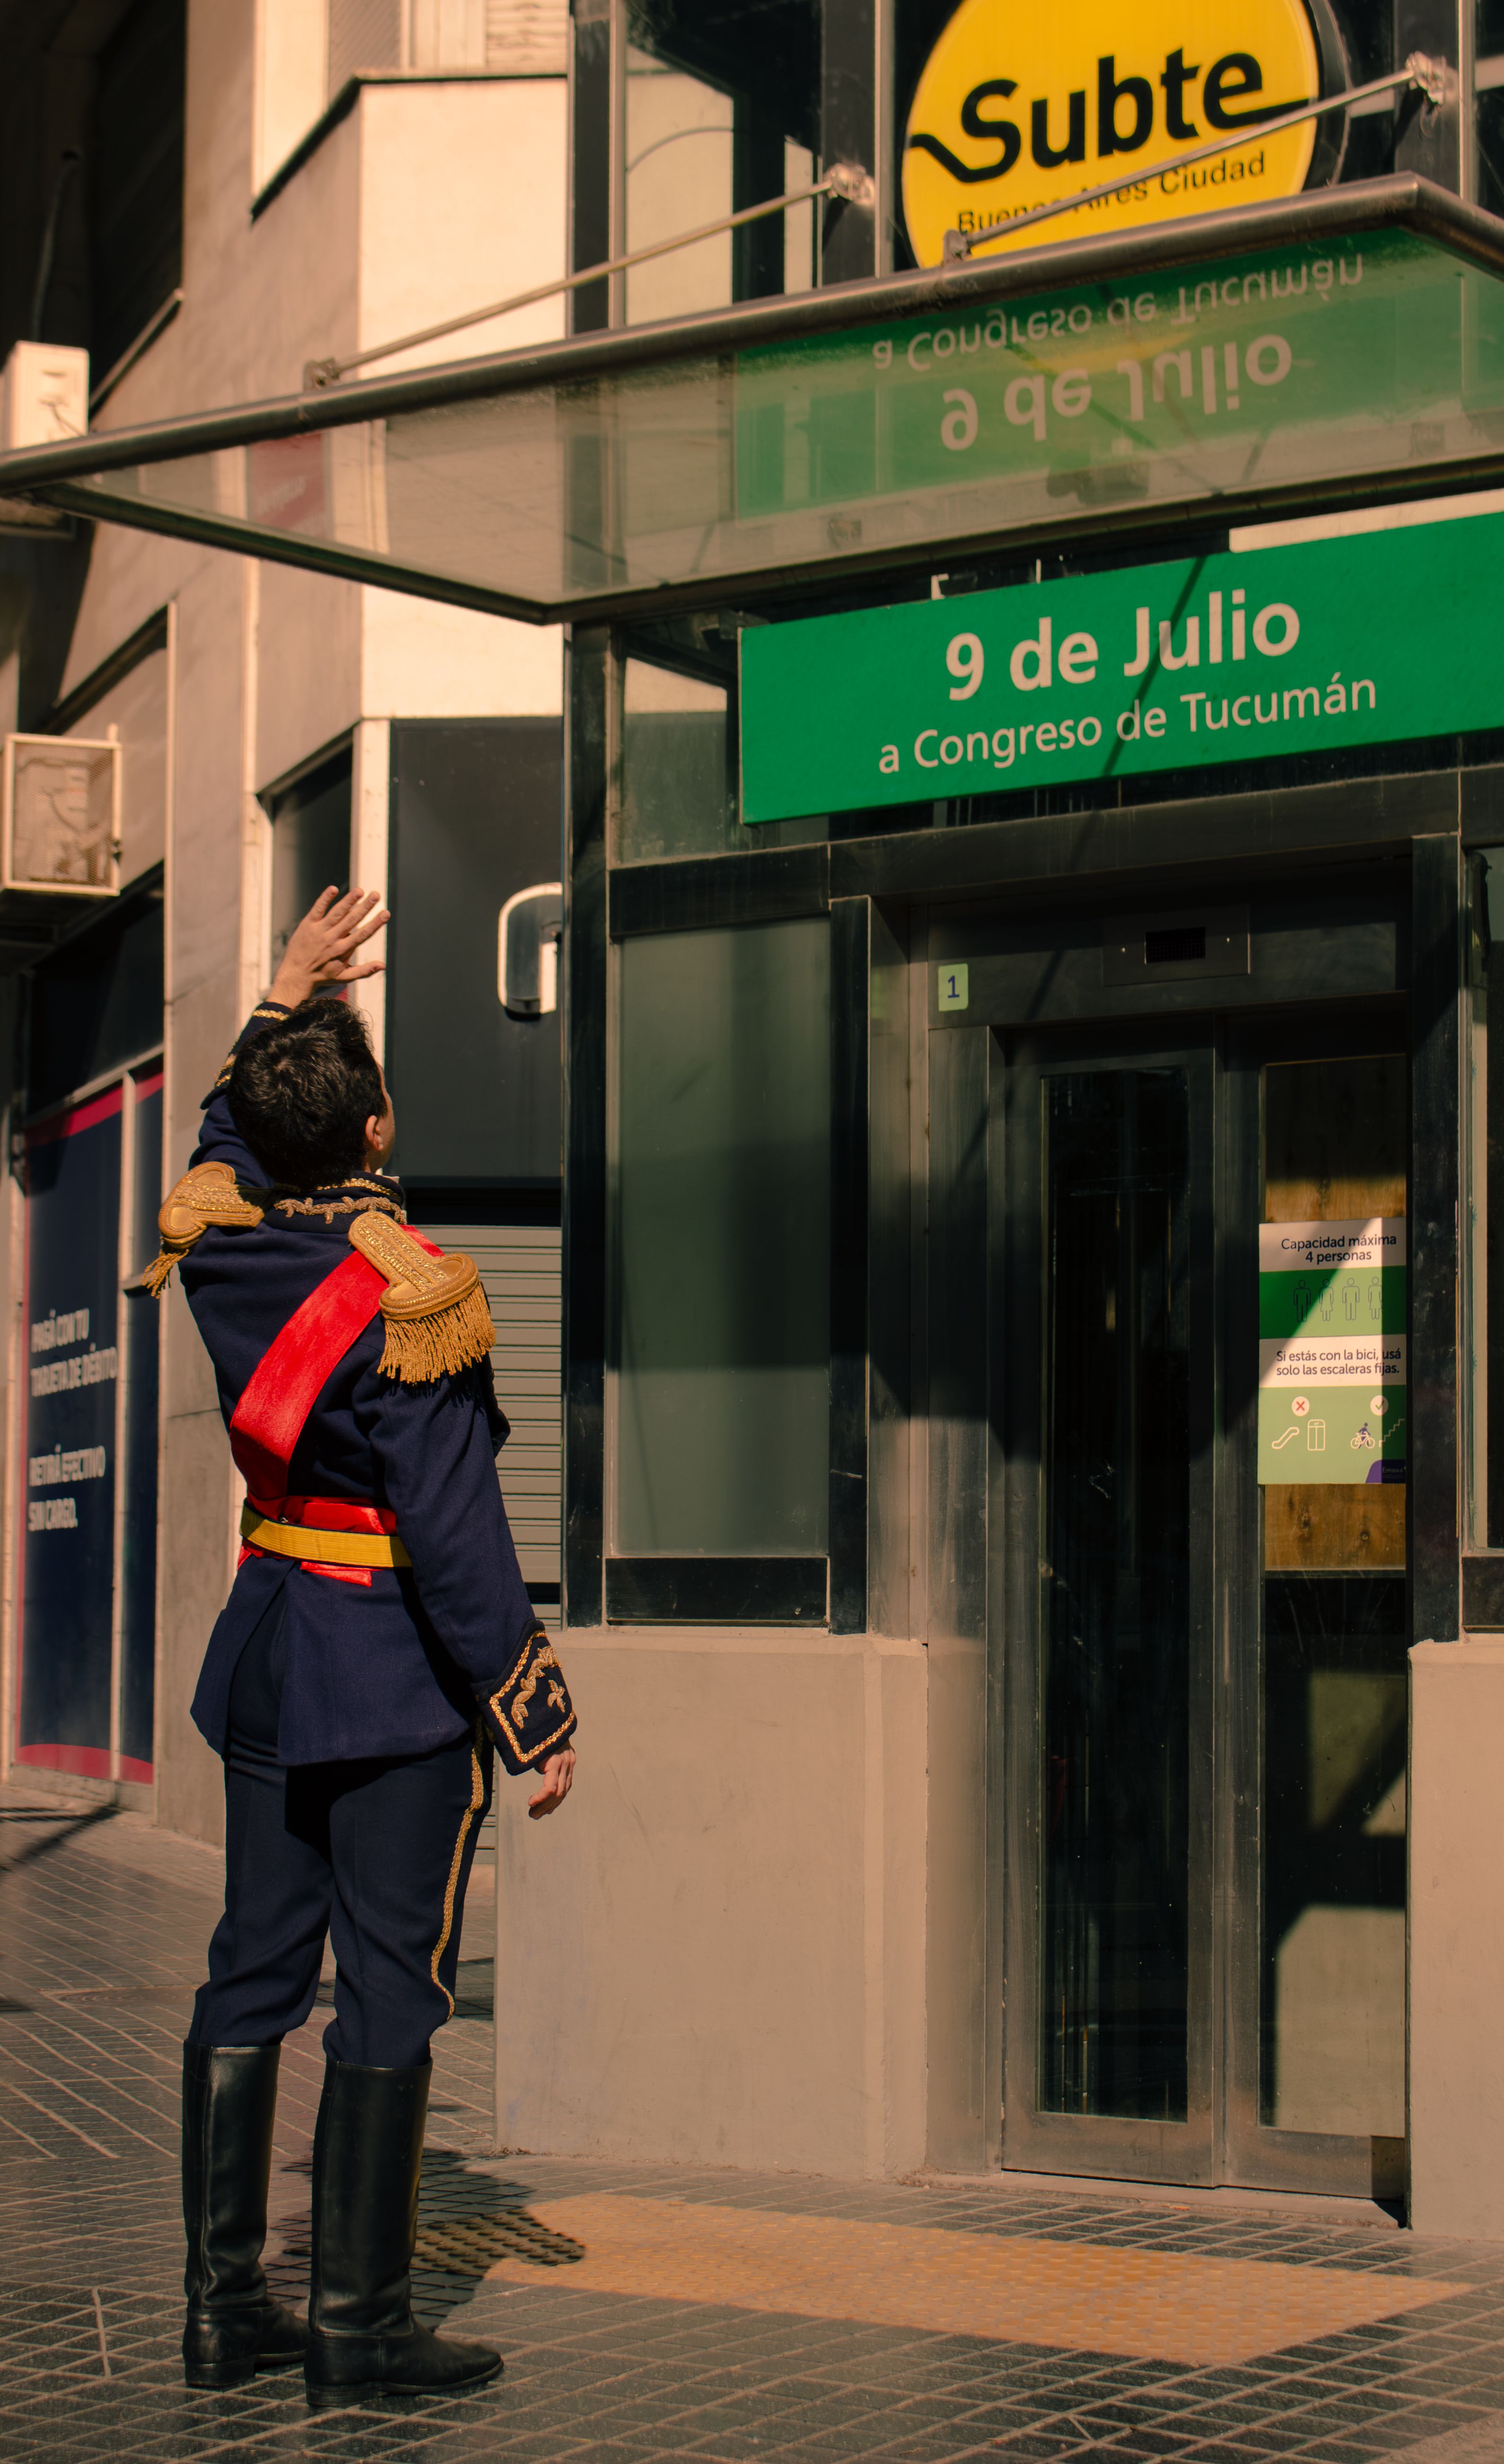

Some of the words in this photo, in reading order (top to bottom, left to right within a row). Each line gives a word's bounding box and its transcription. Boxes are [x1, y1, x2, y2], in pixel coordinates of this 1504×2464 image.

[910, 46, 1310, 185] Subte
[1159, 151, 1265, 195] Ciudad
[947, 633, 984, 701] 9
[1009, 616, 1099, 691] de
[1124, 588, 1301, 677] Julio
[879, 744, 899, 774] a
[914, 716, 1102, 769] Congreso
[1116, 700, 1167, 741] de
[1180, 672, 1377, 733] Tucumán
[947, 975, 960, 998] 1
[1281, 1235, 1345, 1252] Capacidad
[1348, 1234, 1397, 1247] máxima
[1305, 1251, 1313, 1262] 4
[1317, 1251, 1371, 1265] personas
[1276, 1350, 1286, 1362] Si
[1289, 1350, 1317, 1361] estás
[1319, 1352, 1341, 1361] con
[1344, 1349, 1353, 1360] la
[1356, 1349, 1379, 1361] bici,
[1382, 1348, 1401, 1360] usá
[1276, 1364, 1300, 1376] solo
[1303, 1364, 1318, 1375] las
[1320, 1363, 1371, 1374] escaleras
[1374, 1362, 1400, 1376] fijas.
